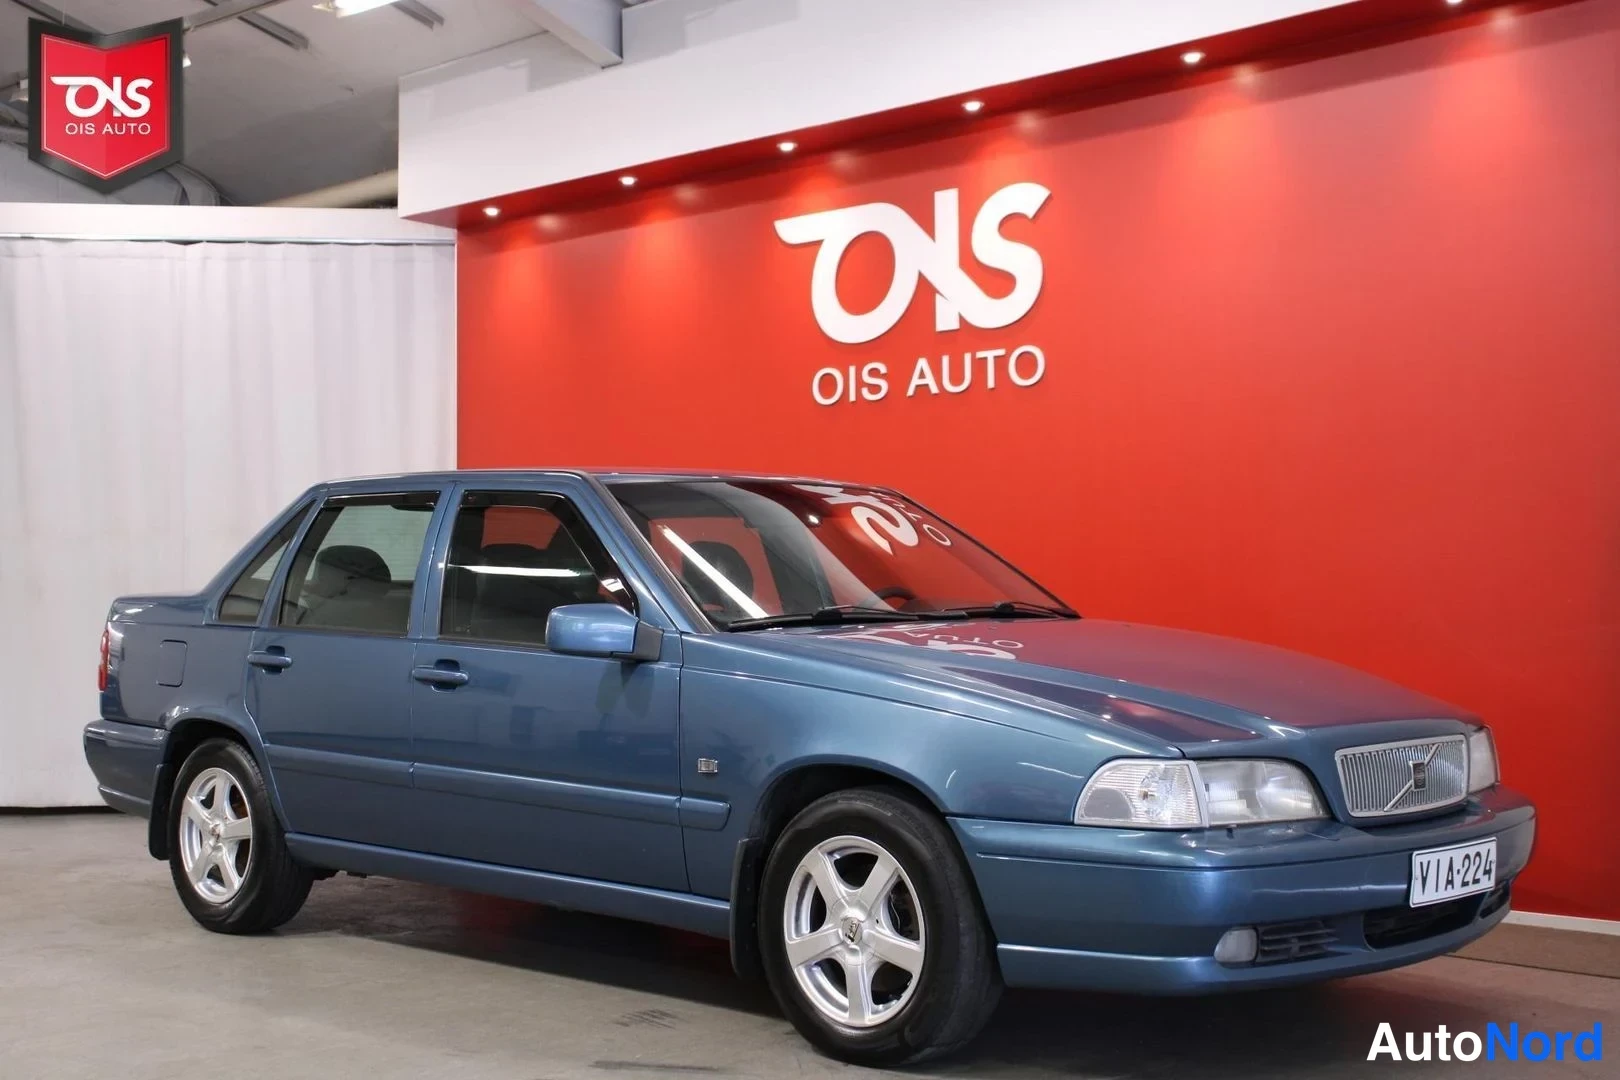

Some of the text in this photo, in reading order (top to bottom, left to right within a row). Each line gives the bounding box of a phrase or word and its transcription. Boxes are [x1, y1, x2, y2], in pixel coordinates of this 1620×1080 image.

[812, 345, 1046, 406] OIS AUTO
[1419, 848, 1493, 895] VIA-224
